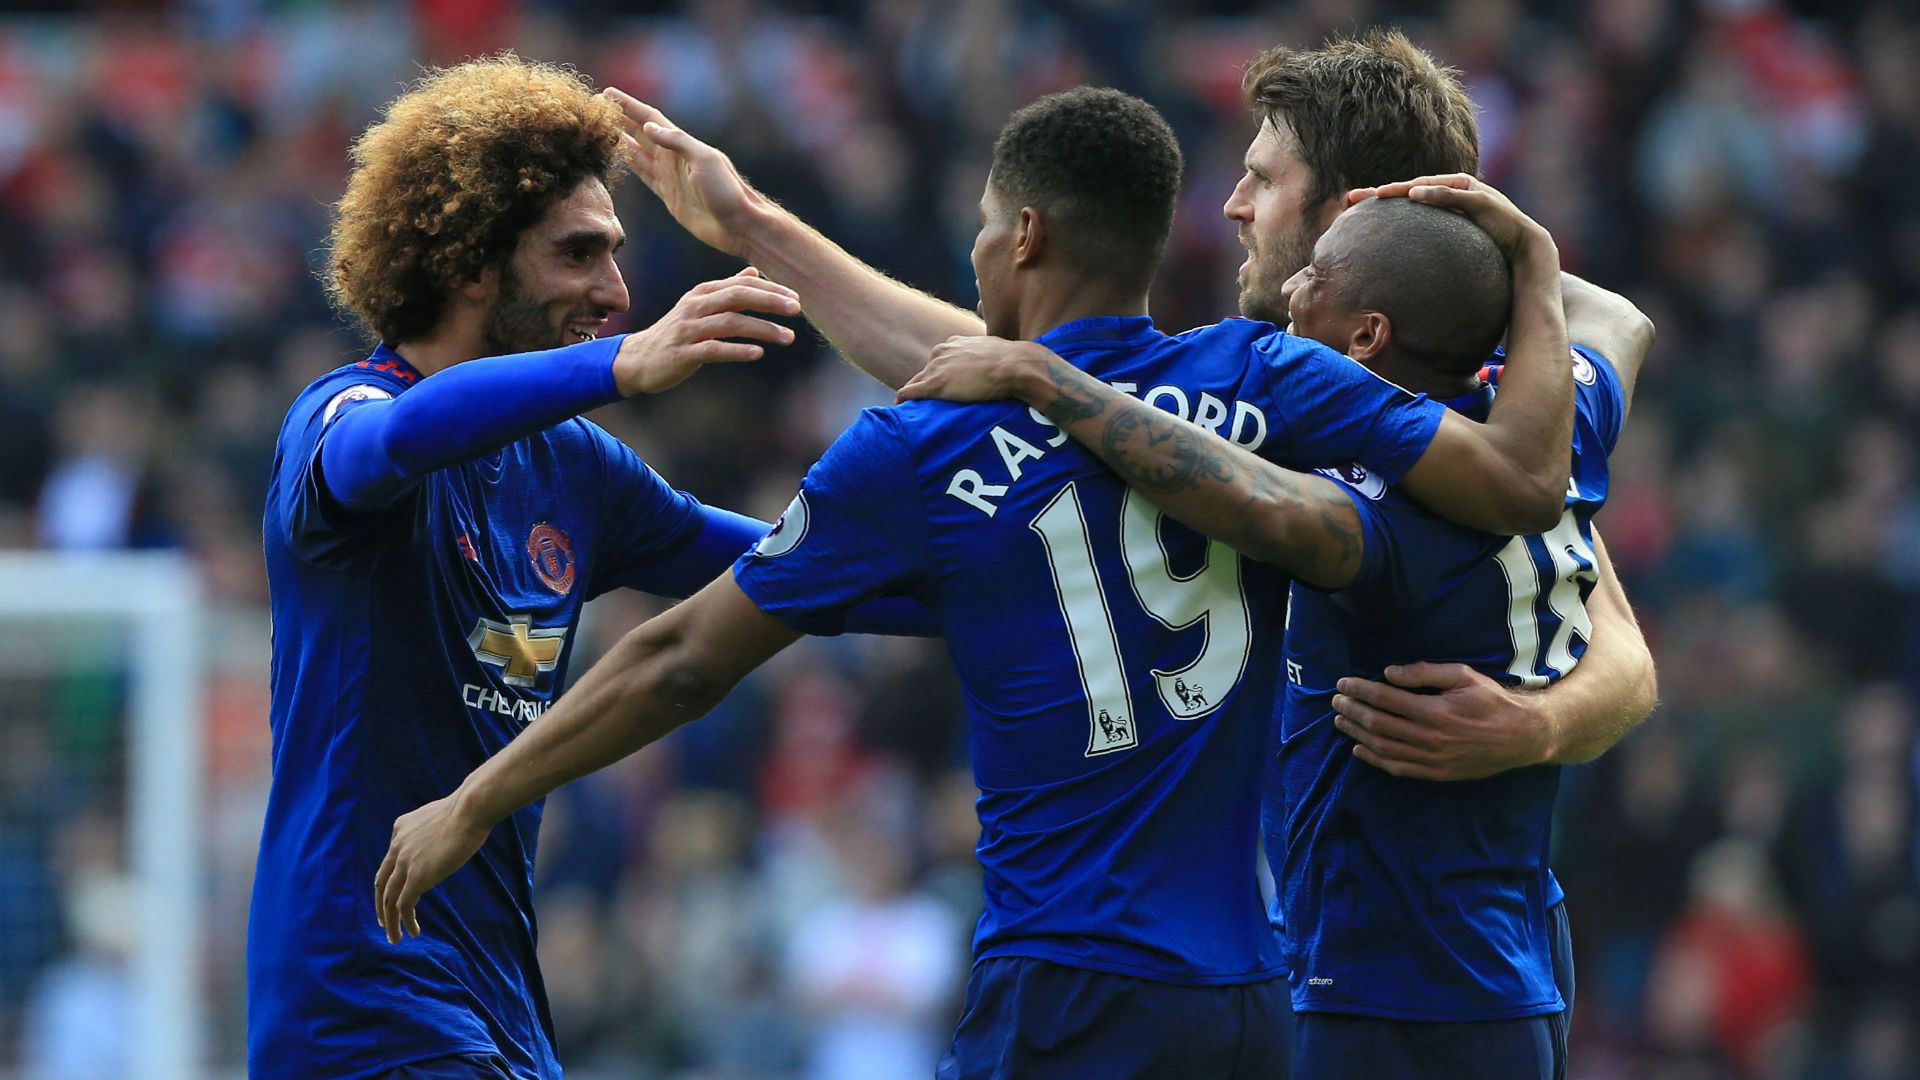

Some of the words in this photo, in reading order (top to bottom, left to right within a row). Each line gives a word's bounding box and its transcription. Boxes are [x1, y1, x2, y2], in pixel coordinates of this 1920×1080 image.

[945, 381, 1267, 518] RASORD
[1029, 480, 1253, 758] 19
[1493, 508, 1600, 690] 18
